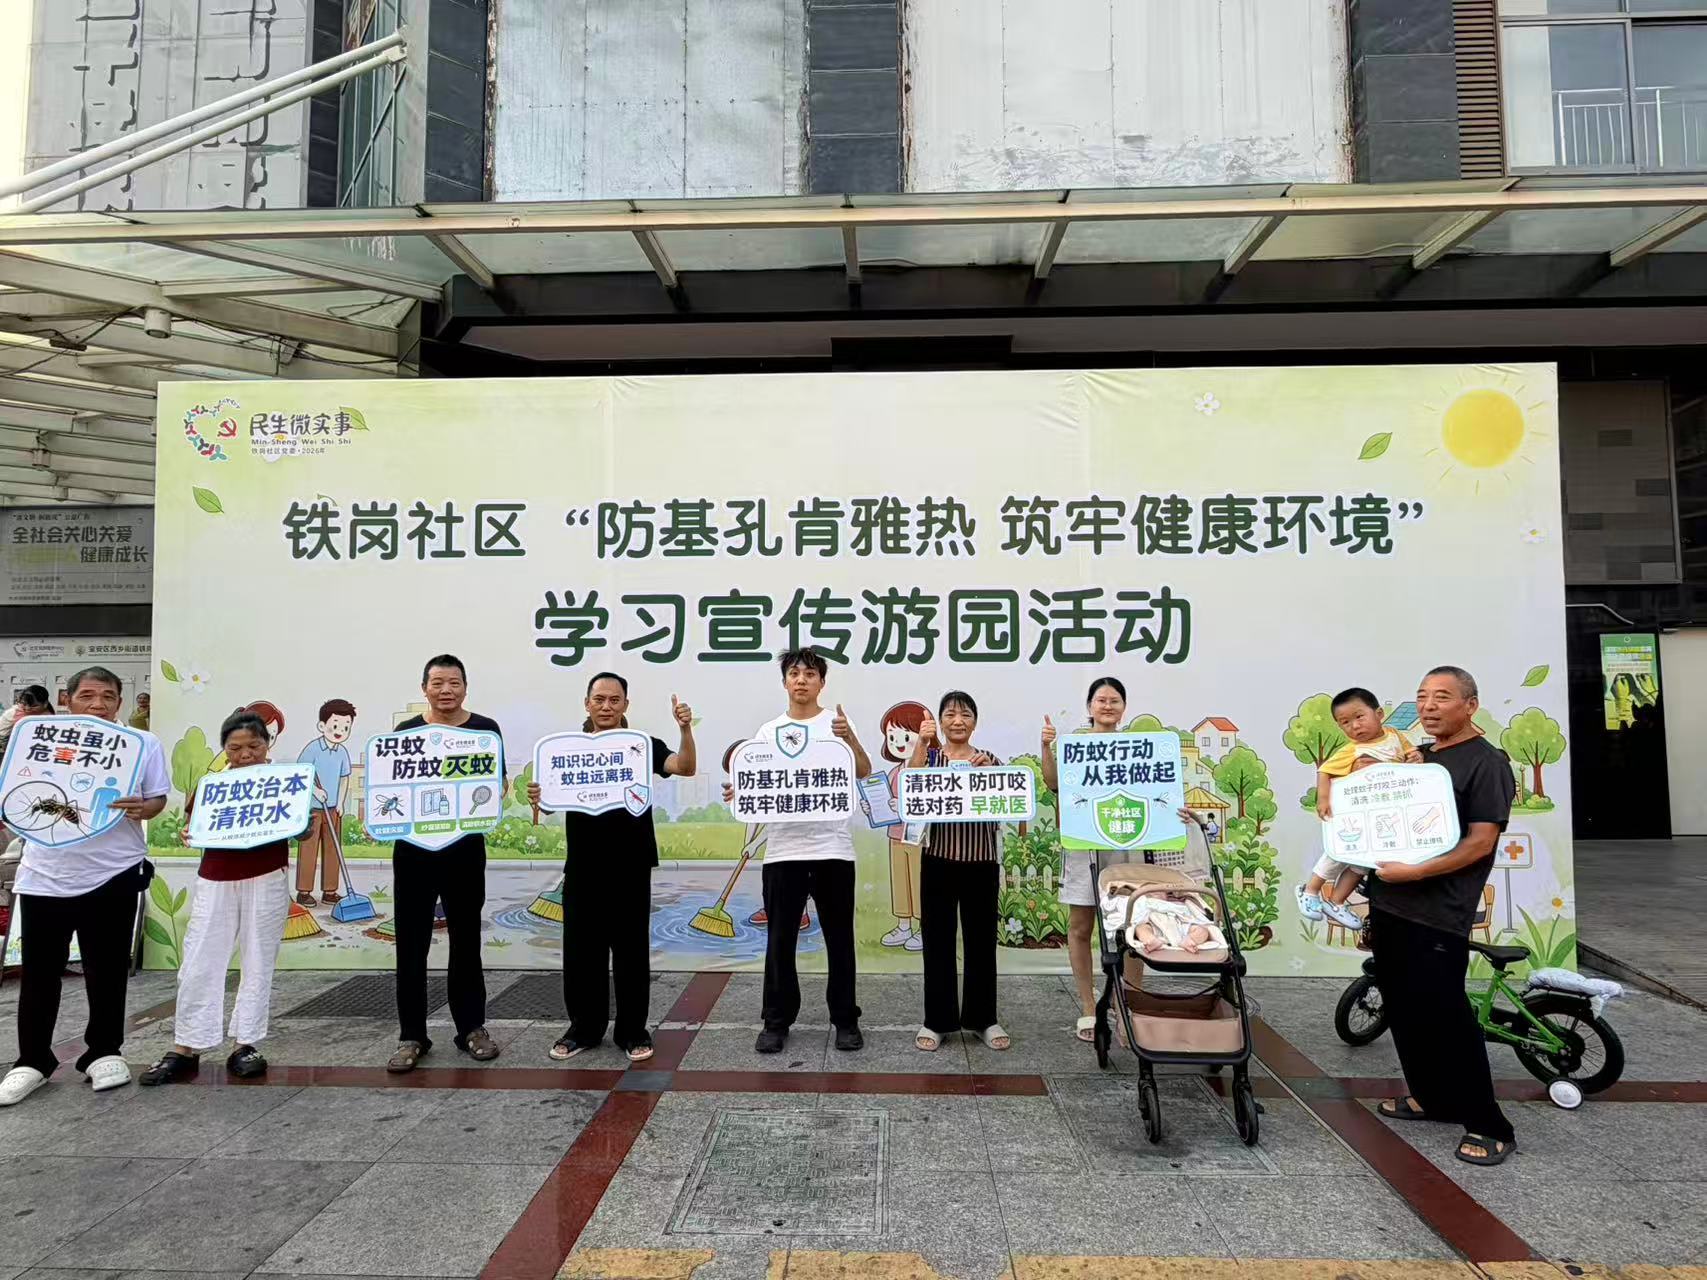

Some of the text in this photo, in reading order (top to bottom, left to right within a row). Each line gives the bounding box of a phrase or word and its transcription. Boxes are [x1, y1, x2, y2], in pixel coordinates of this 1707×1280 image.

[249, 411, 352, 436] 民生微实事
[13, 526, 133, 544] 全社会关心关爱
[282, 493, 1423, 560] 铁岗社区 “防基孔肯雅热 筑牢健康环境”
[80, 546, 149, 563] 健康成长
[534, 587, 1192, 667] 学习宣传游园活动
[32, 724, 127, 751] 蚊虫虽小
[375, 736, 426, 757] 识蚊
[26, 743, 122, 770] 危害不小
[551, 752, 624, 769] 知识记心间
[1064, 738, 1154, 764] 防蚊行动
[392, 754, 495, 780] 防蚊灭蚊
[561, 768, 634, 786] 蚊虫远离我
[738, 767, 849, 790] 防基孔肯雅热
[1081, 761, 1176, 786] 从我做起
[201, 773, 308, 806] 防蚊治本
[905, 772, 1027, 793] 清积水 防叮咬
[738, 792, 850, 814] 筑牢健康环境
[906, 795, 1028, 816] 选对药 早就医
[1101, 807, 1143, 818] 干净社区
[208, 800, 292, 831] 清积水
[1108, 820, 1136, 834] 健康
